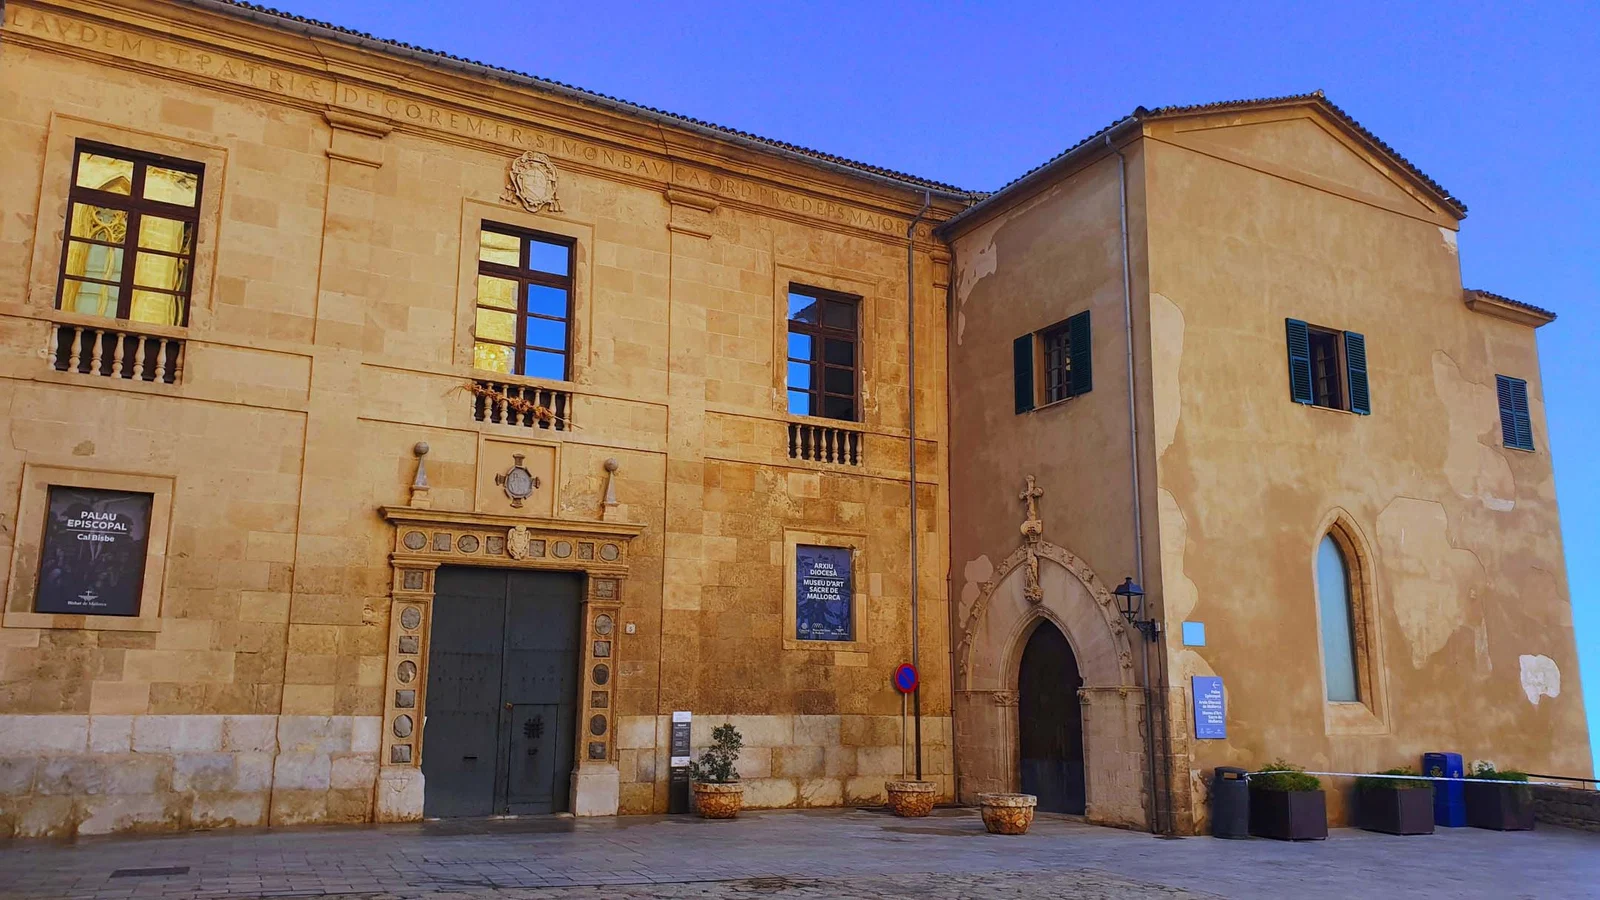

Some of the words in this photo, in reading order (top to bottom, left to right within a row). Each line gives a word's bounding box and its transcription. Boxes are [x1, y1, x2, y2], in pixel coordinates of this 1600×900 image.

[80, 511, 117, 521] PALAU
[67, 519, 128, 531] EPISCOPAL
[77, 533, 91, 541] Cal
[91, 534, 115, 542] Bisbe
[814, 562, 834, 570] ARXIU
[810, 568, 838, 577] DIOCESÀ
[803, 579, 826, 587] MUSEU
[826, 580, 844, 588] D'ART
[809, 586, 829, 594] SACRE
[806, 593, 841, 601] MALLORCA
